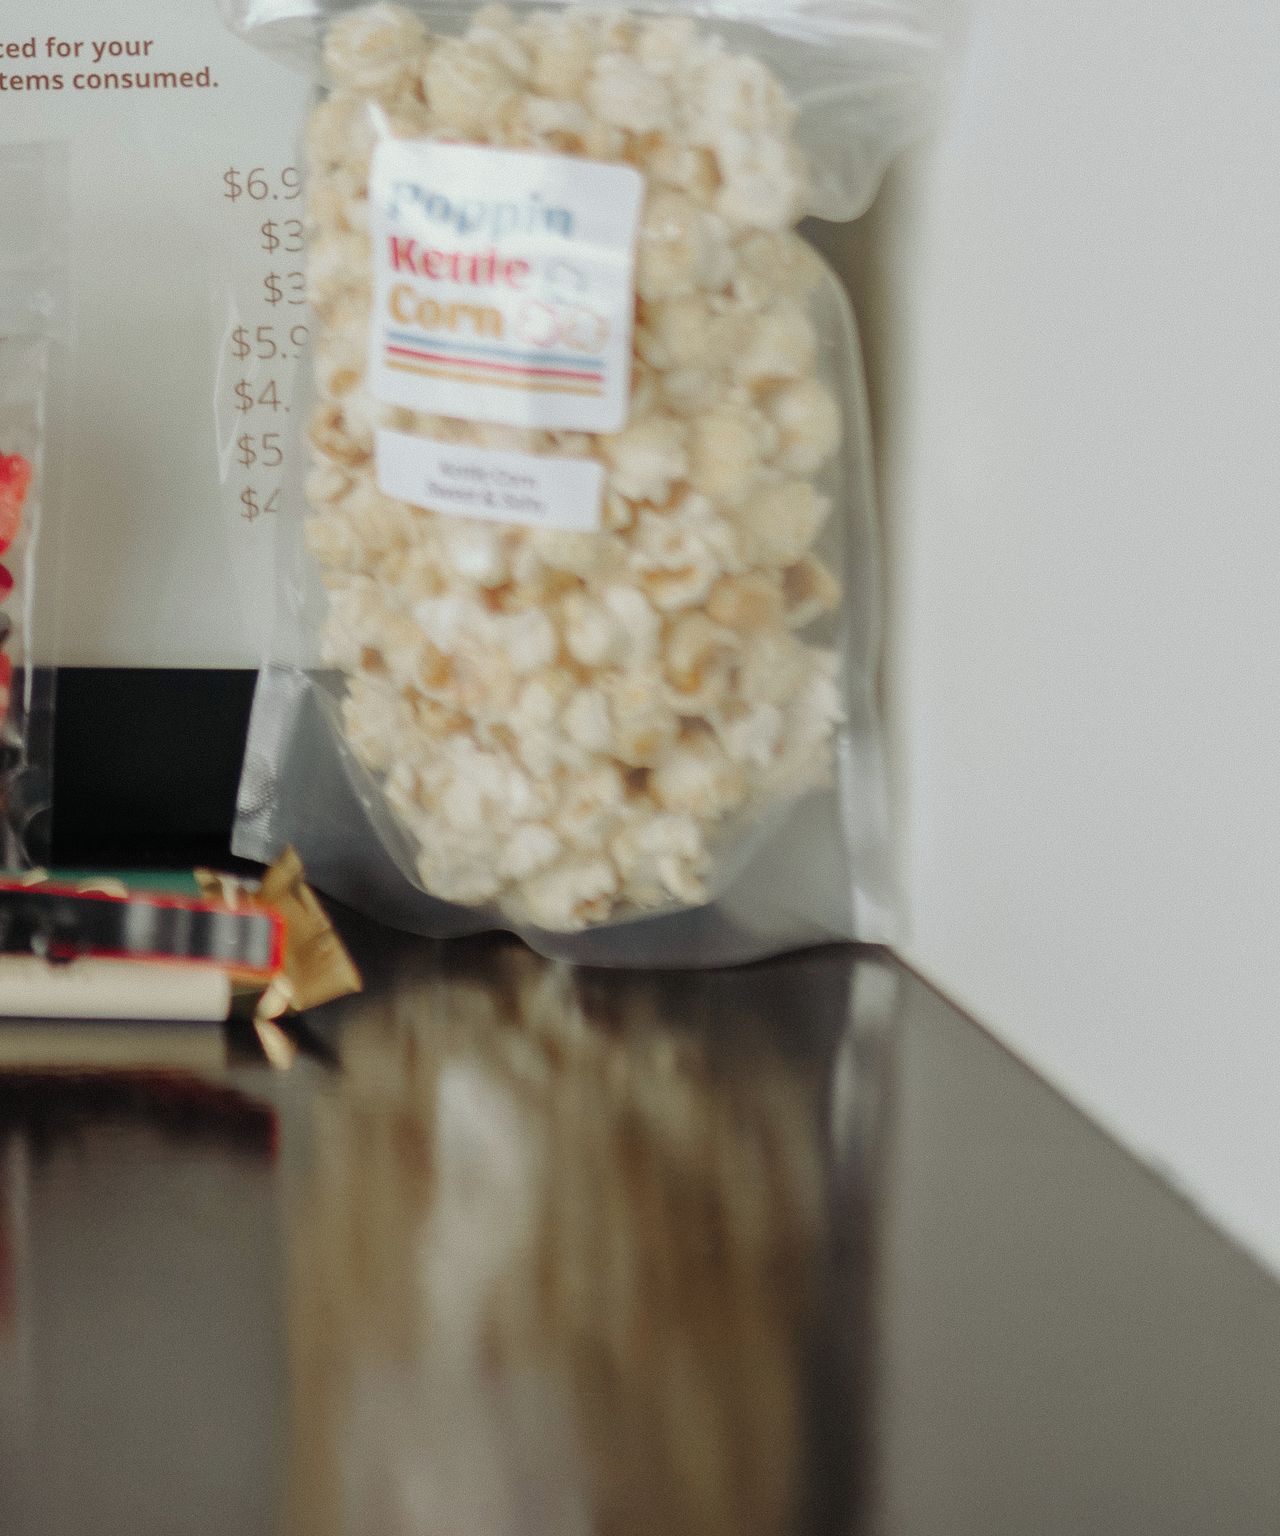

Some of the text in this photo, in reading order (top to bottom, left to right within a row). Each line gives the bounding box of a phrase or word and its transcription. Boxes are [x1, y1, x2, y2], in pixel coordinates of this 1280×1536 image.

[44, 35, 85, 59] for
[91, 39, 154, 64] your
[72, 65, 220, 91] consumed.
[388, 234, 534, 291] Kettle
[388, 282, 505, 341] Corn
